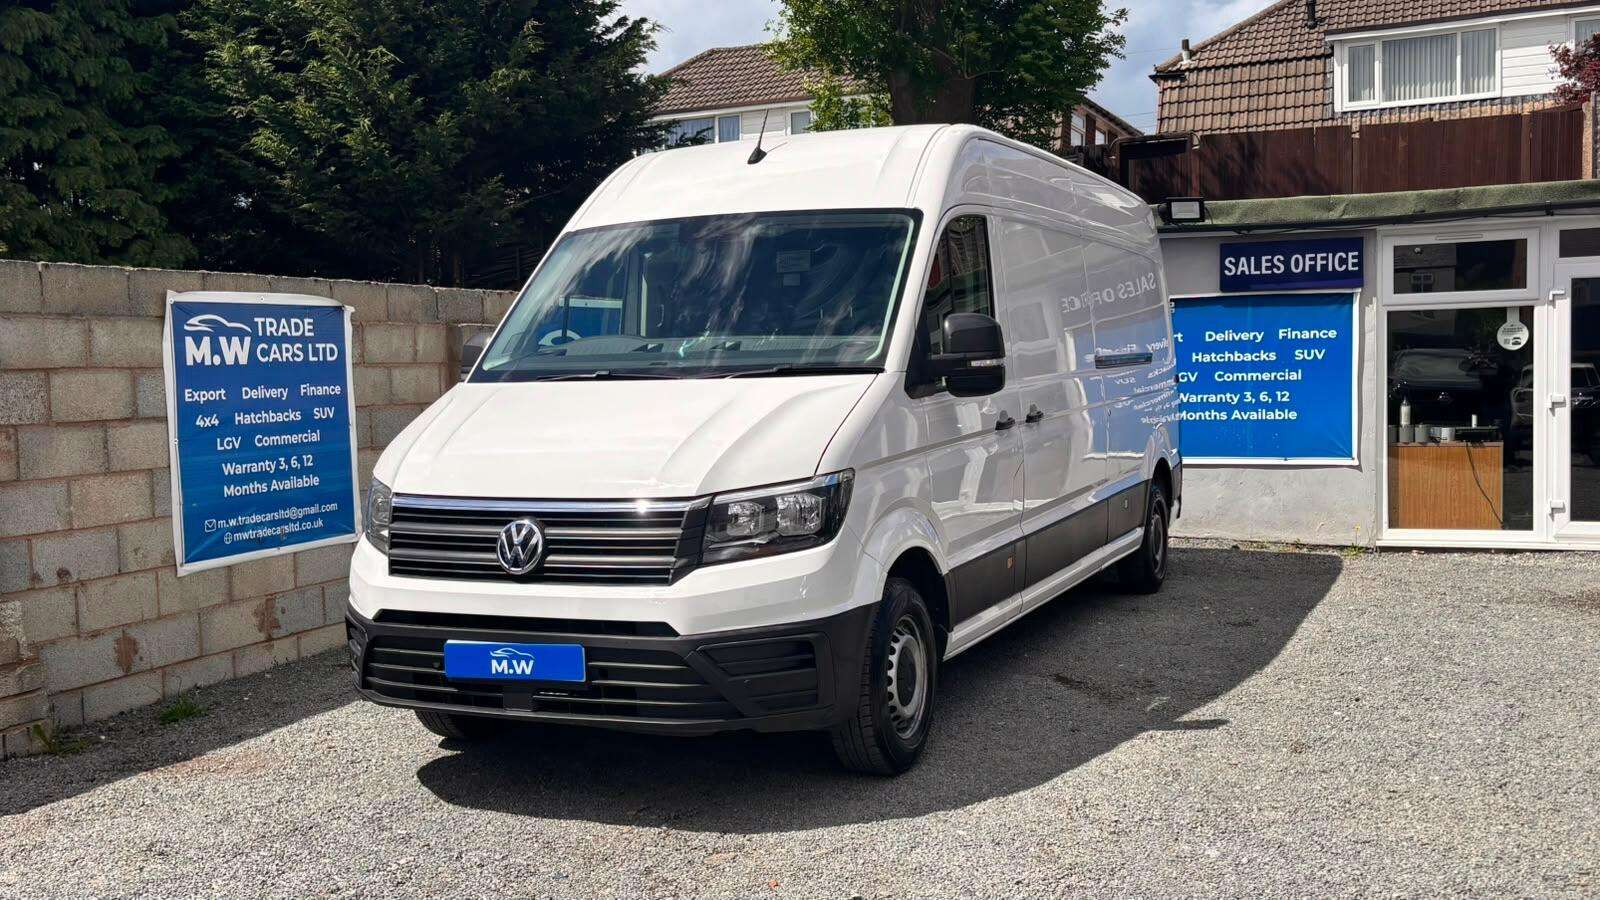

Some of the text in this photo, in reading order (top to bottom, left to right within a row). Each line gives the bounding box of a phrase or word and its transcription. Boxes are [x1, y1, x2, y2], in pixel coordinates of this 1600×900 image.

[1223, 251, 1359, 277] SALES OFFICE
[254, 317, 314, 337] TRADE
[1205, 328, 1338, 343] Delivery Finance
[184, 336, 252, 366] M.W
[256, 343, 339, 363] CARS LTD
[1192, 349, 1325, 363] Hatchbacks SUV
[1178, 369, 1302, 383] GV Commercial
[184, 383, 342, 404] Export Delivery Finance
[1243, 391, 1256, 404] 3,
[1259, 391, 1273, 404] 6,
[1275, 391, 1290, 402] 12
[195, 406, 335, 428] 4x4 Hatchbacks SUV
[1231, 409, 1298, 420] Available
[216, 429, 320, 451] LGV Commercial
[222, 454, 314, 476] Warranty 3, 6, 12
[223, 474, 320, 498] Months Available
[217, 502, 338, 529] m.w.tradecarsltd@gmail.com
[233, 518, 324, 542] mwtradecarsltd.co.uk
[491, 659, 534, 675] M.W
